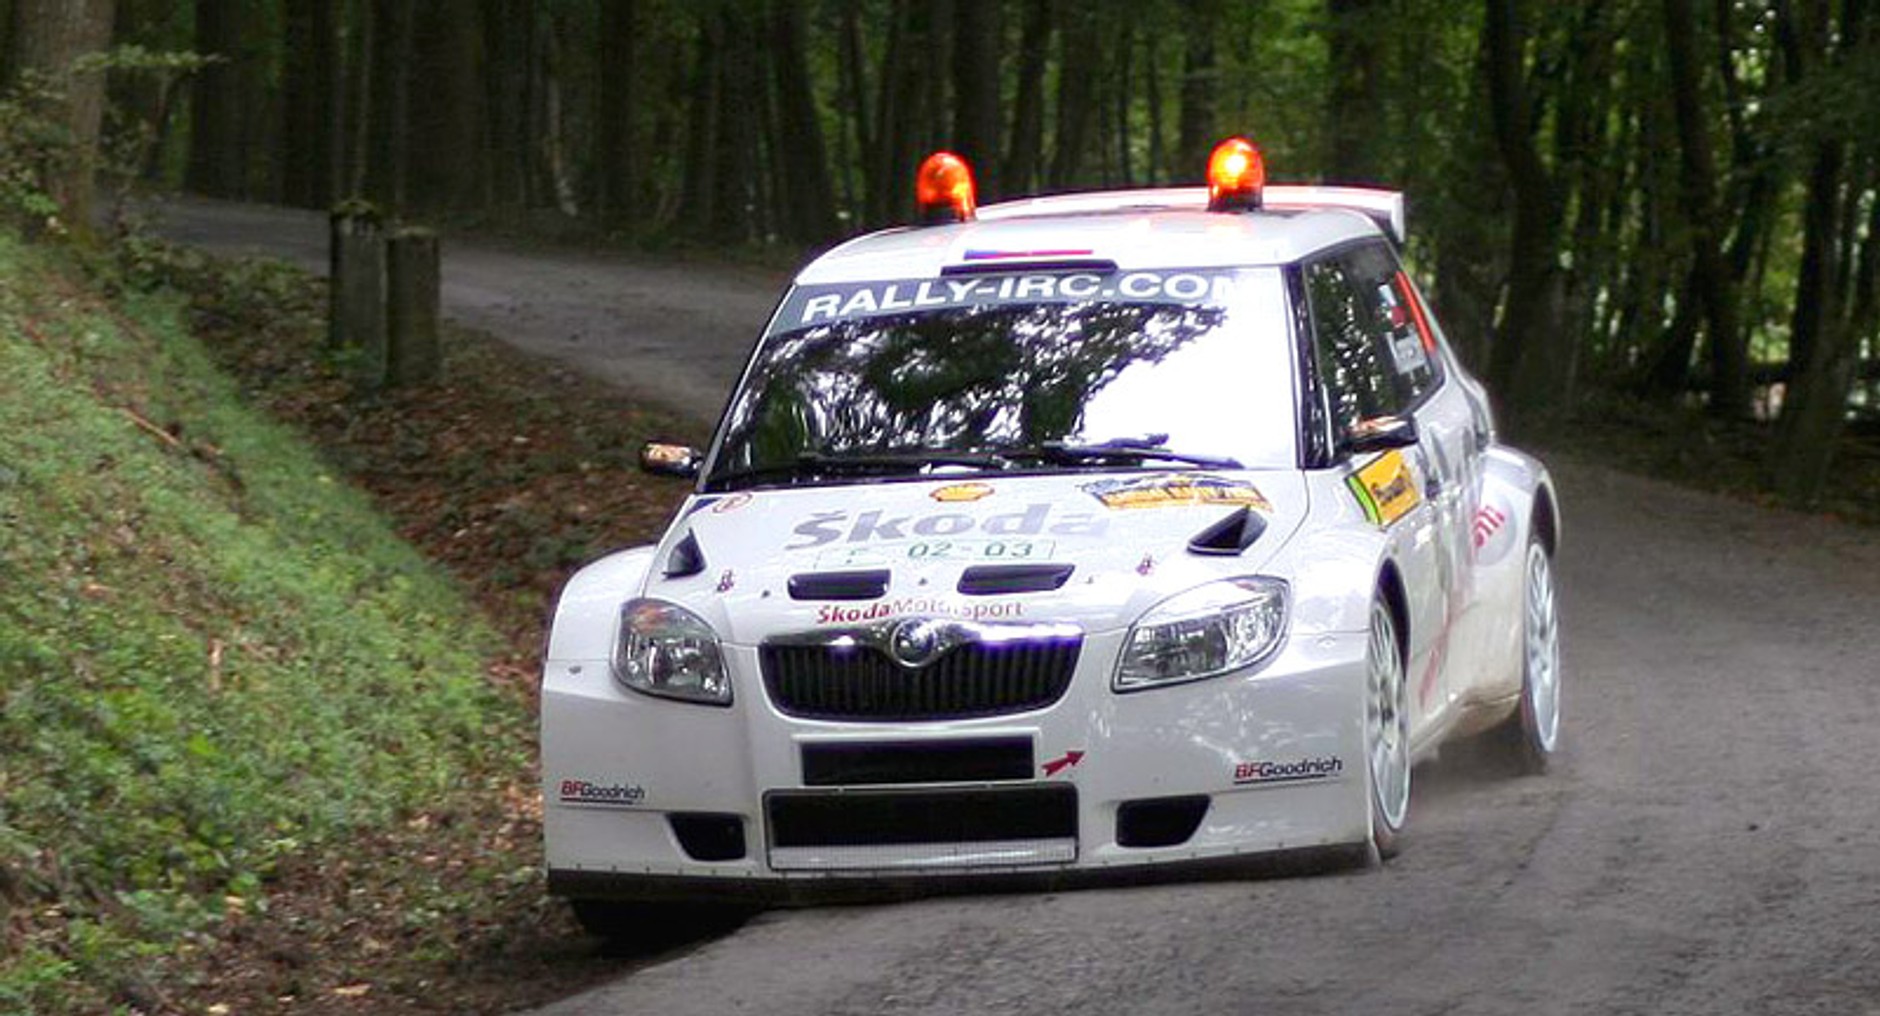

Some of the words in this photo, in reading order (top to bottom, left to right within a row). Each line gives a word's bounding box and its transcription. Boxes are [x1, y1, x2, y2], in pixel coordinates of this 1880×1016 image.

[786, 502, 1110, 550] Škoda
[1234, 757, 1343, 779] BFGoodrich
[561, 780, 646, 799] BFGoodrich
